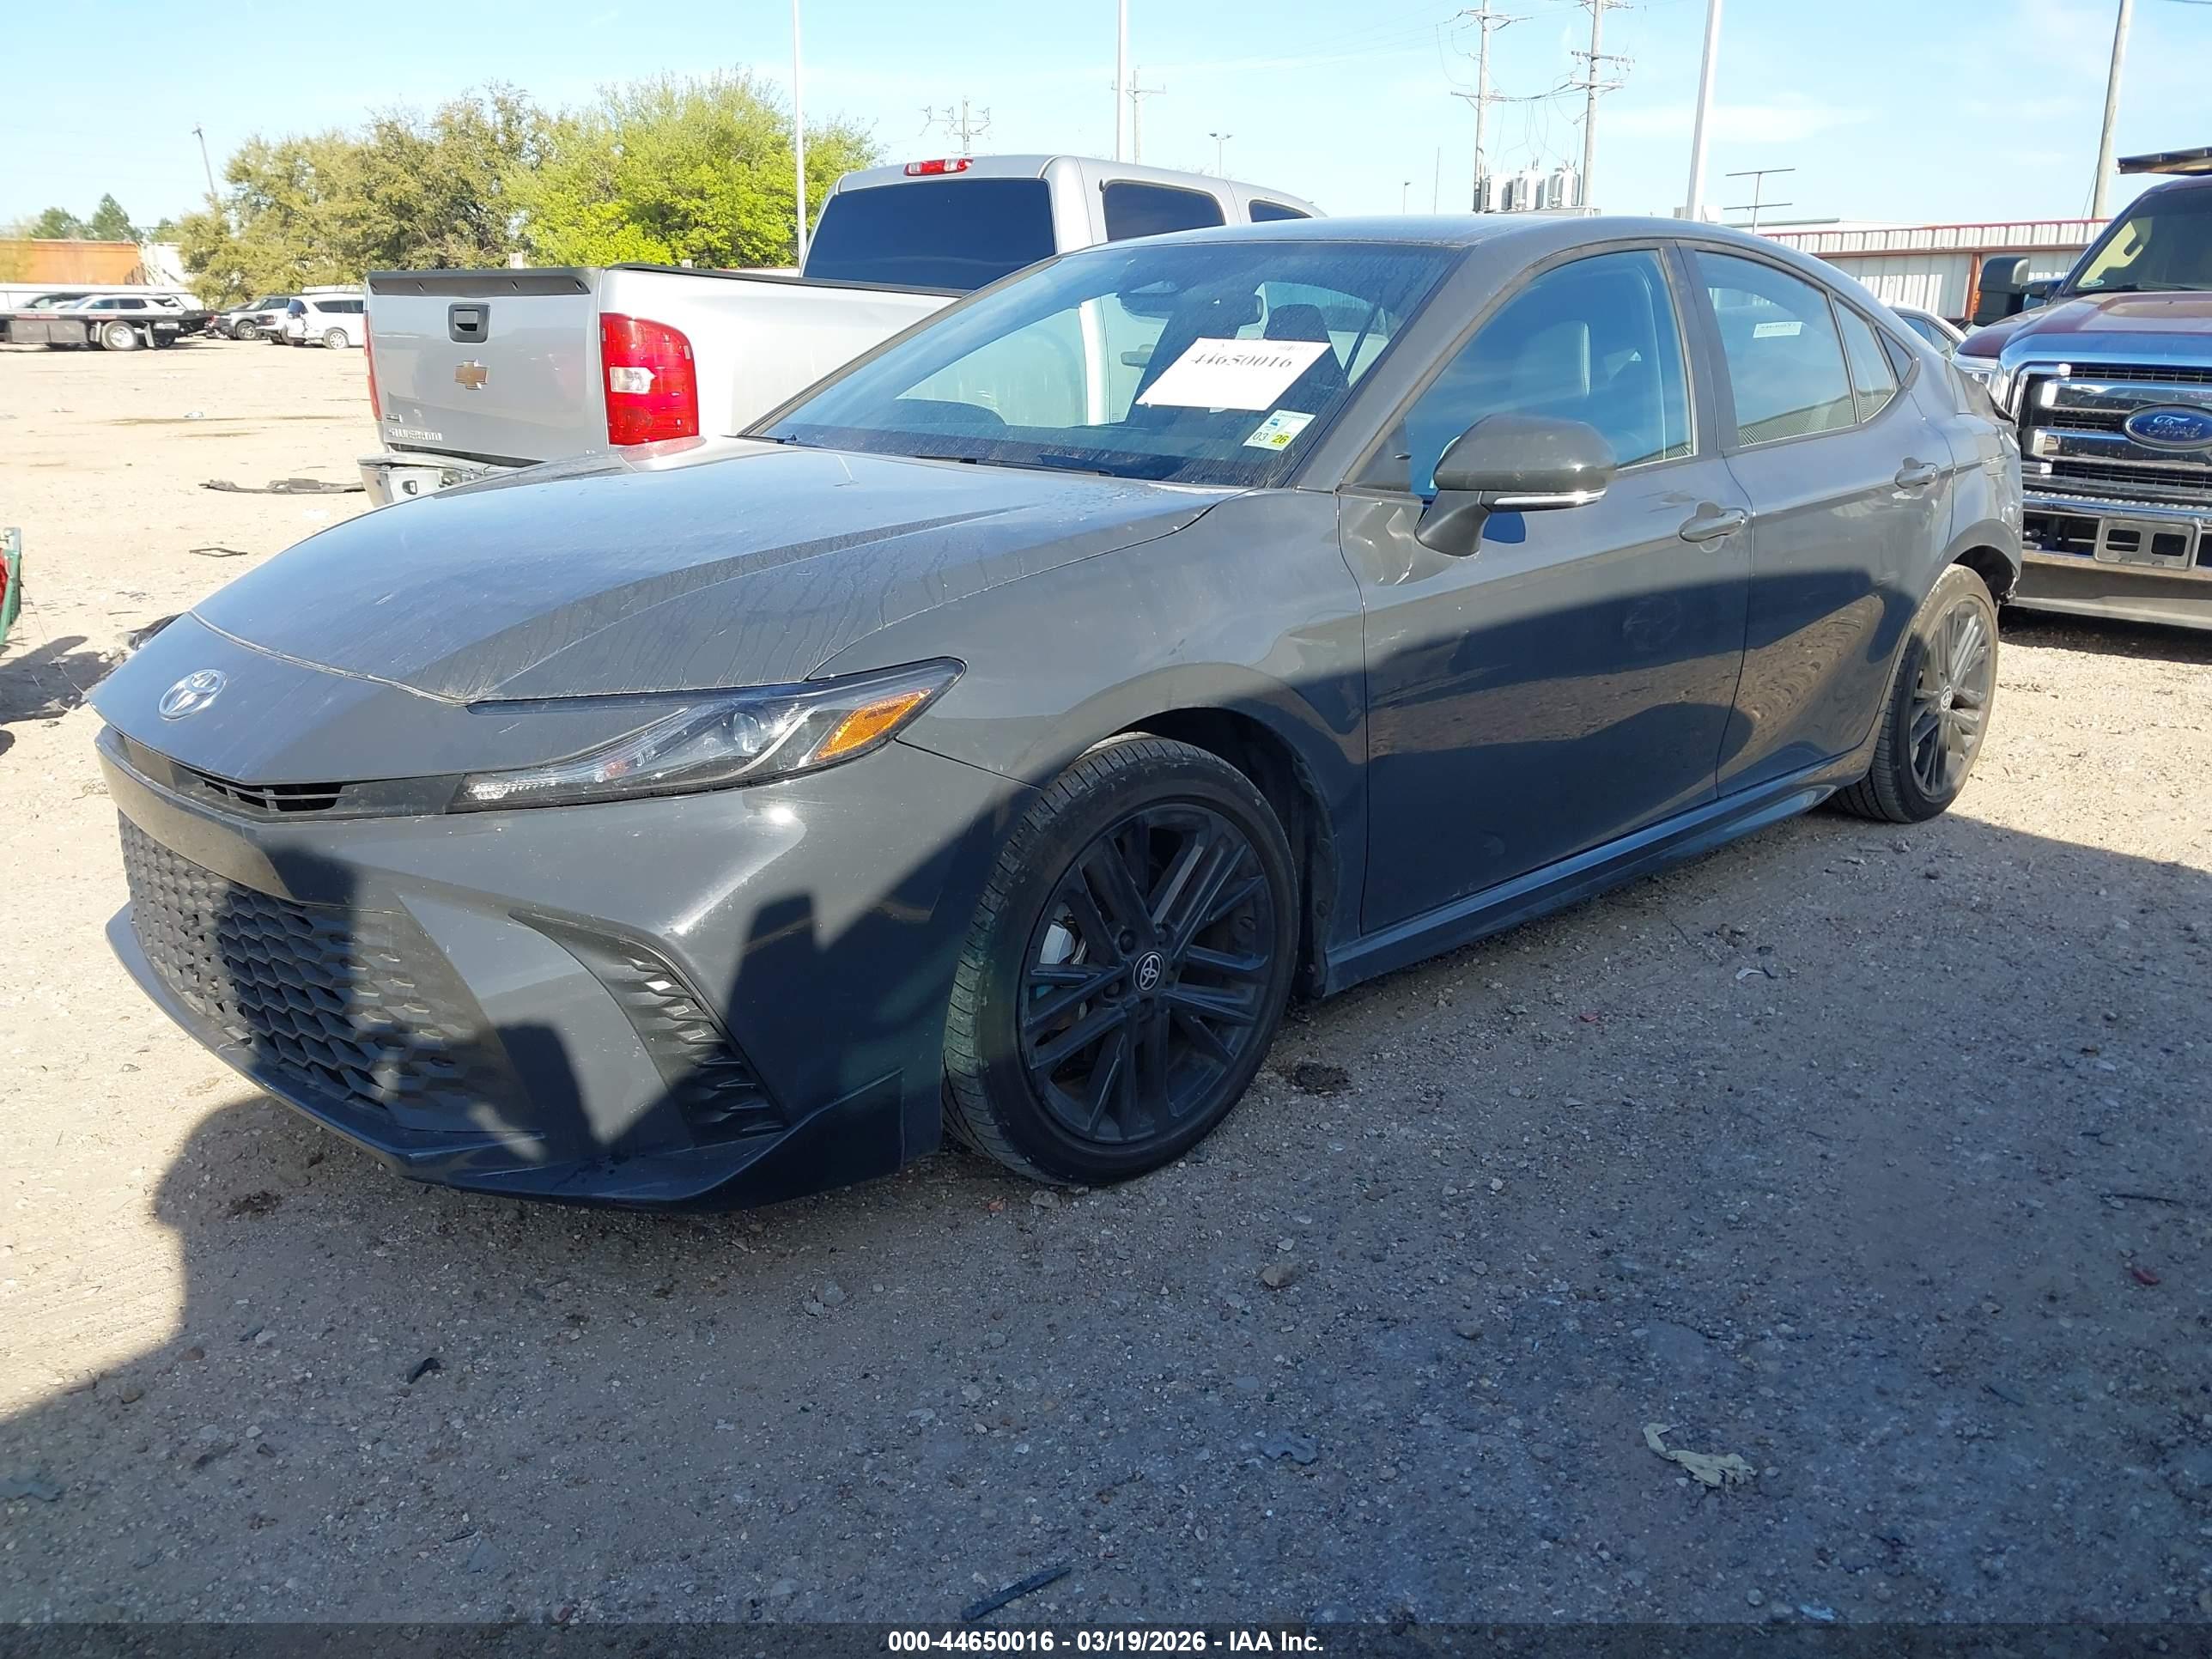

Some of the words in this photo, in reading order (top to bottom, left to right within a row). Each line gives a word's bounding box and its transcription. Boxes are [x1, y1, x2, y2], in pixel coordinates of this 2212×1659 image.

[1191, 353, 1292, 368] 44650016
[2147, 415, 2203, 438] Ford
[1253, 431, 1268, 441] 03
[1271, 434, 1290, 444] 26
